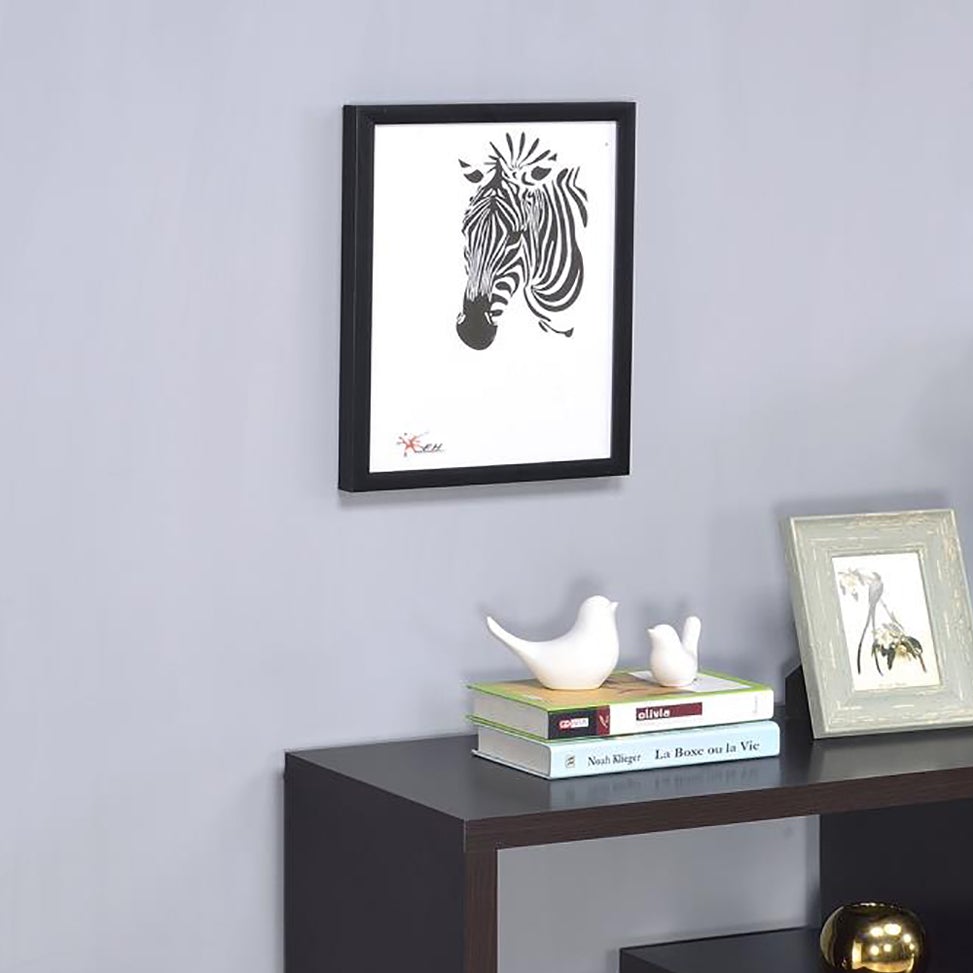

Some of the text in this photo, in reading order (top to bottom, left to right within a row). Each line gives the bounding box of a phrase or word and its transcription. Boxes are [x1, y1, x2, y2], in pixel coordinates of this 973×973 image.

[637, 707, 670, 720] olivia
[655, 740, 760, 760] La Boxe ou la Vie
[588, 756, 611, 766] Noah
